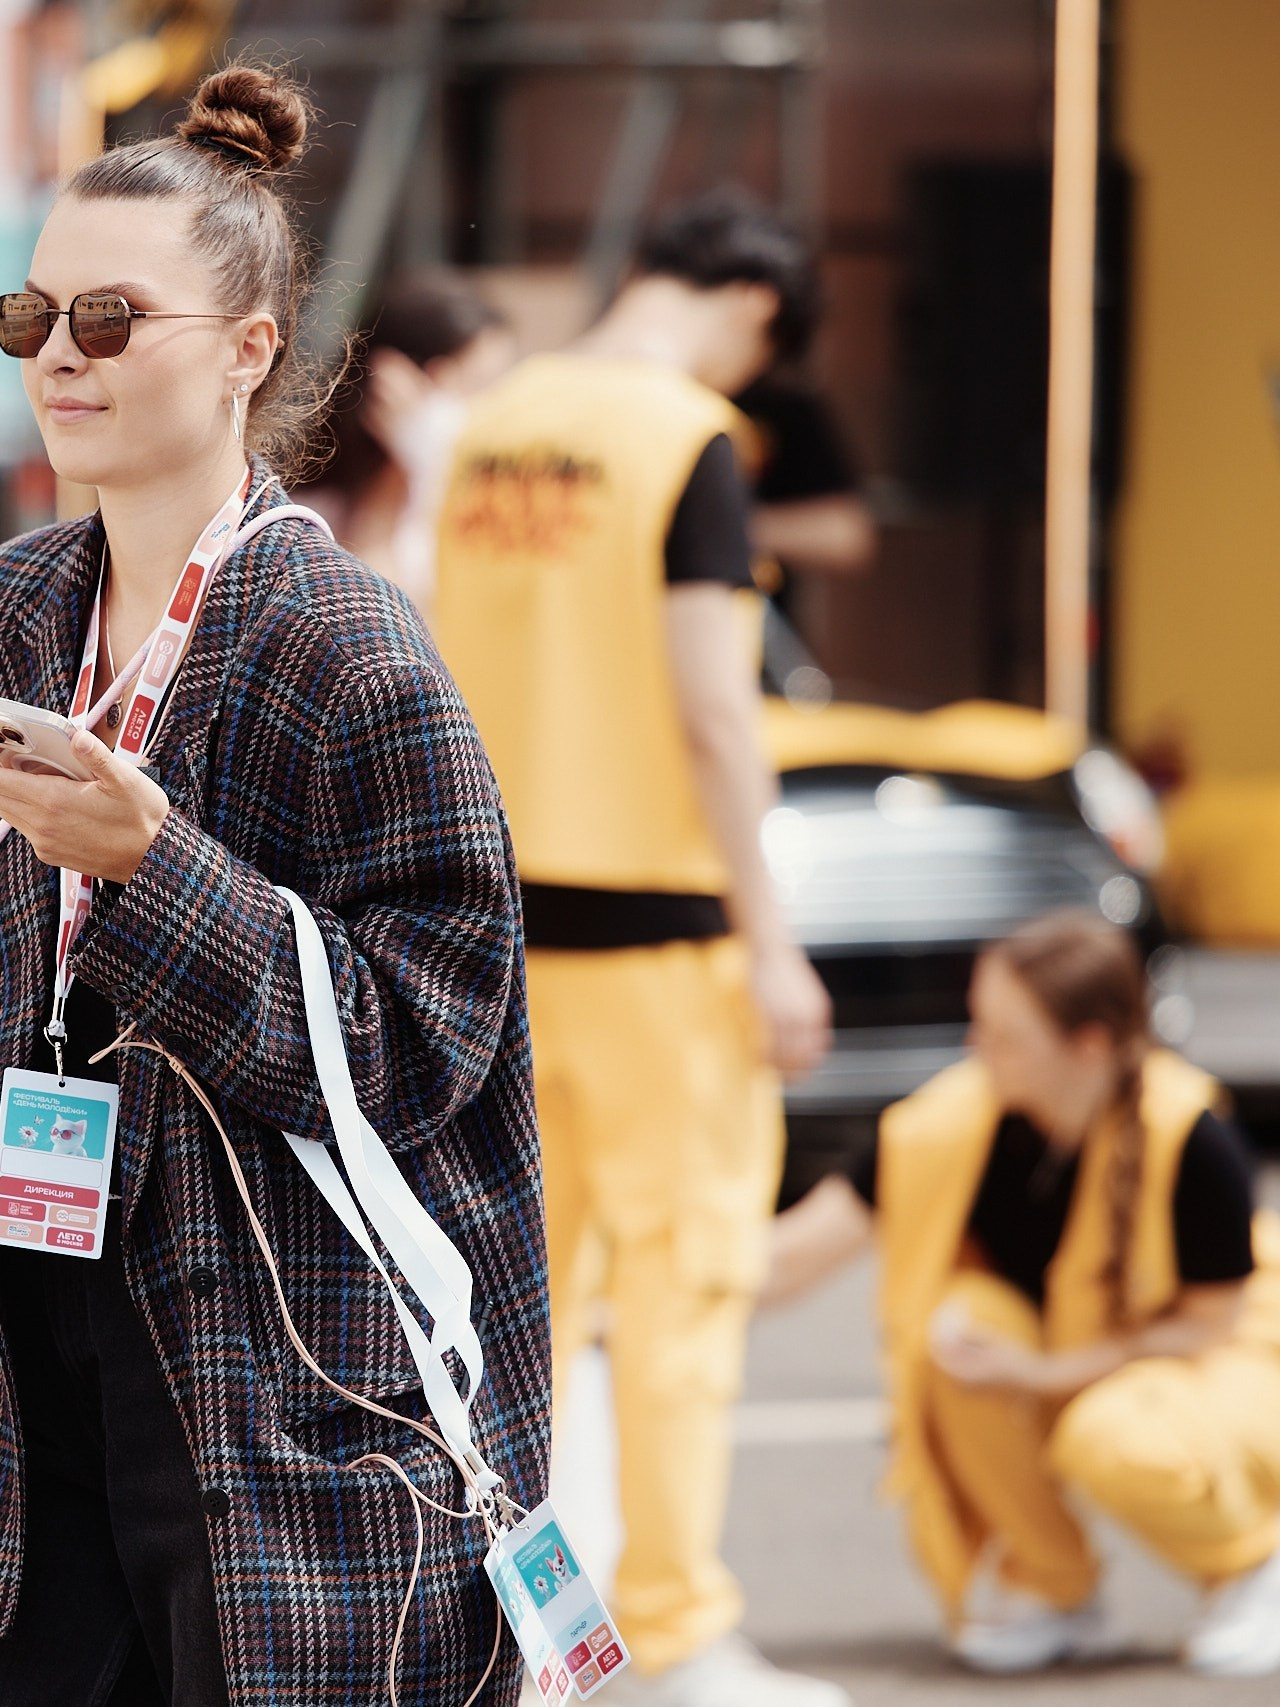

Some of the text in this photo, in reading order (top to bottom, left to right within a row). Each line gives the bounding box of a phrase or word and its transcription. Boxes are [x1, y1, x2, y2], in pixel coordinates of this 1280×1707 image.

[132, 709, 147, 740] ЛЕТО
[13, 1092, 60, 1105] ФЕСТИВАЛЬ
[23, 1185, 74, 1199] ДИРЕКЦИЯ
[57, 1231, 84, 1242] ЛЕТО
